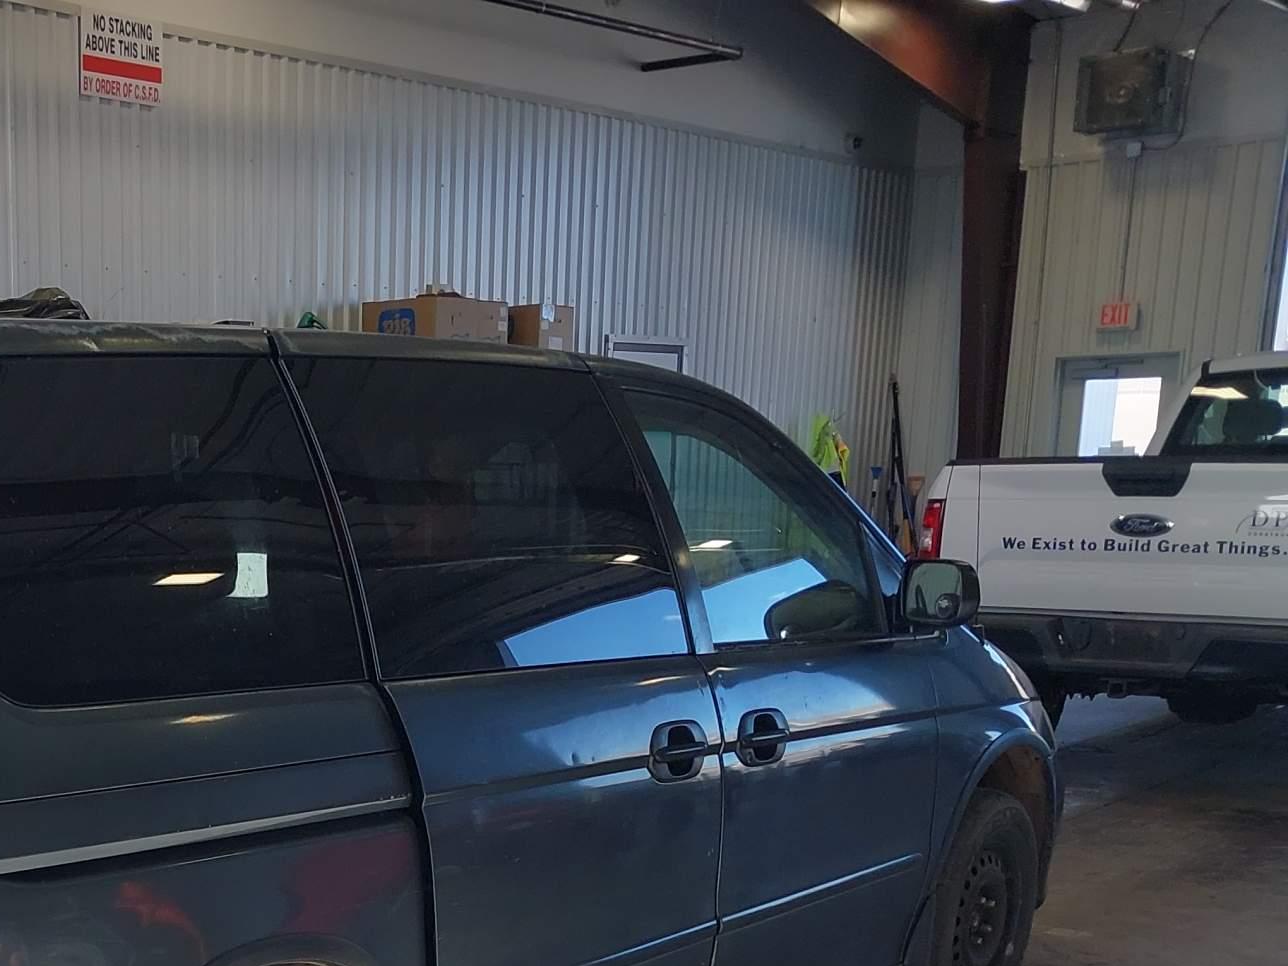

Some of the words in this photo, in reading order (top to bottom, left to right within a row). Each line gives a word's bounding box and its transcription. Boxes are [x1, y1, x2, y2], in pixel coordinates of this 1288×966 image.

[93, 15, 106, 31] NO
[108, 17, 153, 41] STACKING
[85, 34, 116, 54] ABOVE
[118, 40, 137, 58] THIS
[140, 44, 160, 62] LINE
[83, 76, 93, 91] BY
[95, 78, 121, 97] ORDER
[123, 82, 133, 98] OF
[134, 84, 161, 103] C.S.F.D.
[1101, 304, 1129, 325] EXIT
[1002, 536, 1027, 550] We
[1031, 537, 1075, 551] Exist
[1080, 538, 1098, 552] to
[1103, 538, 1152, 553] Build
[1157, 539, 1210, 554] Great
[1215, 540, 1288, 558] Things.
